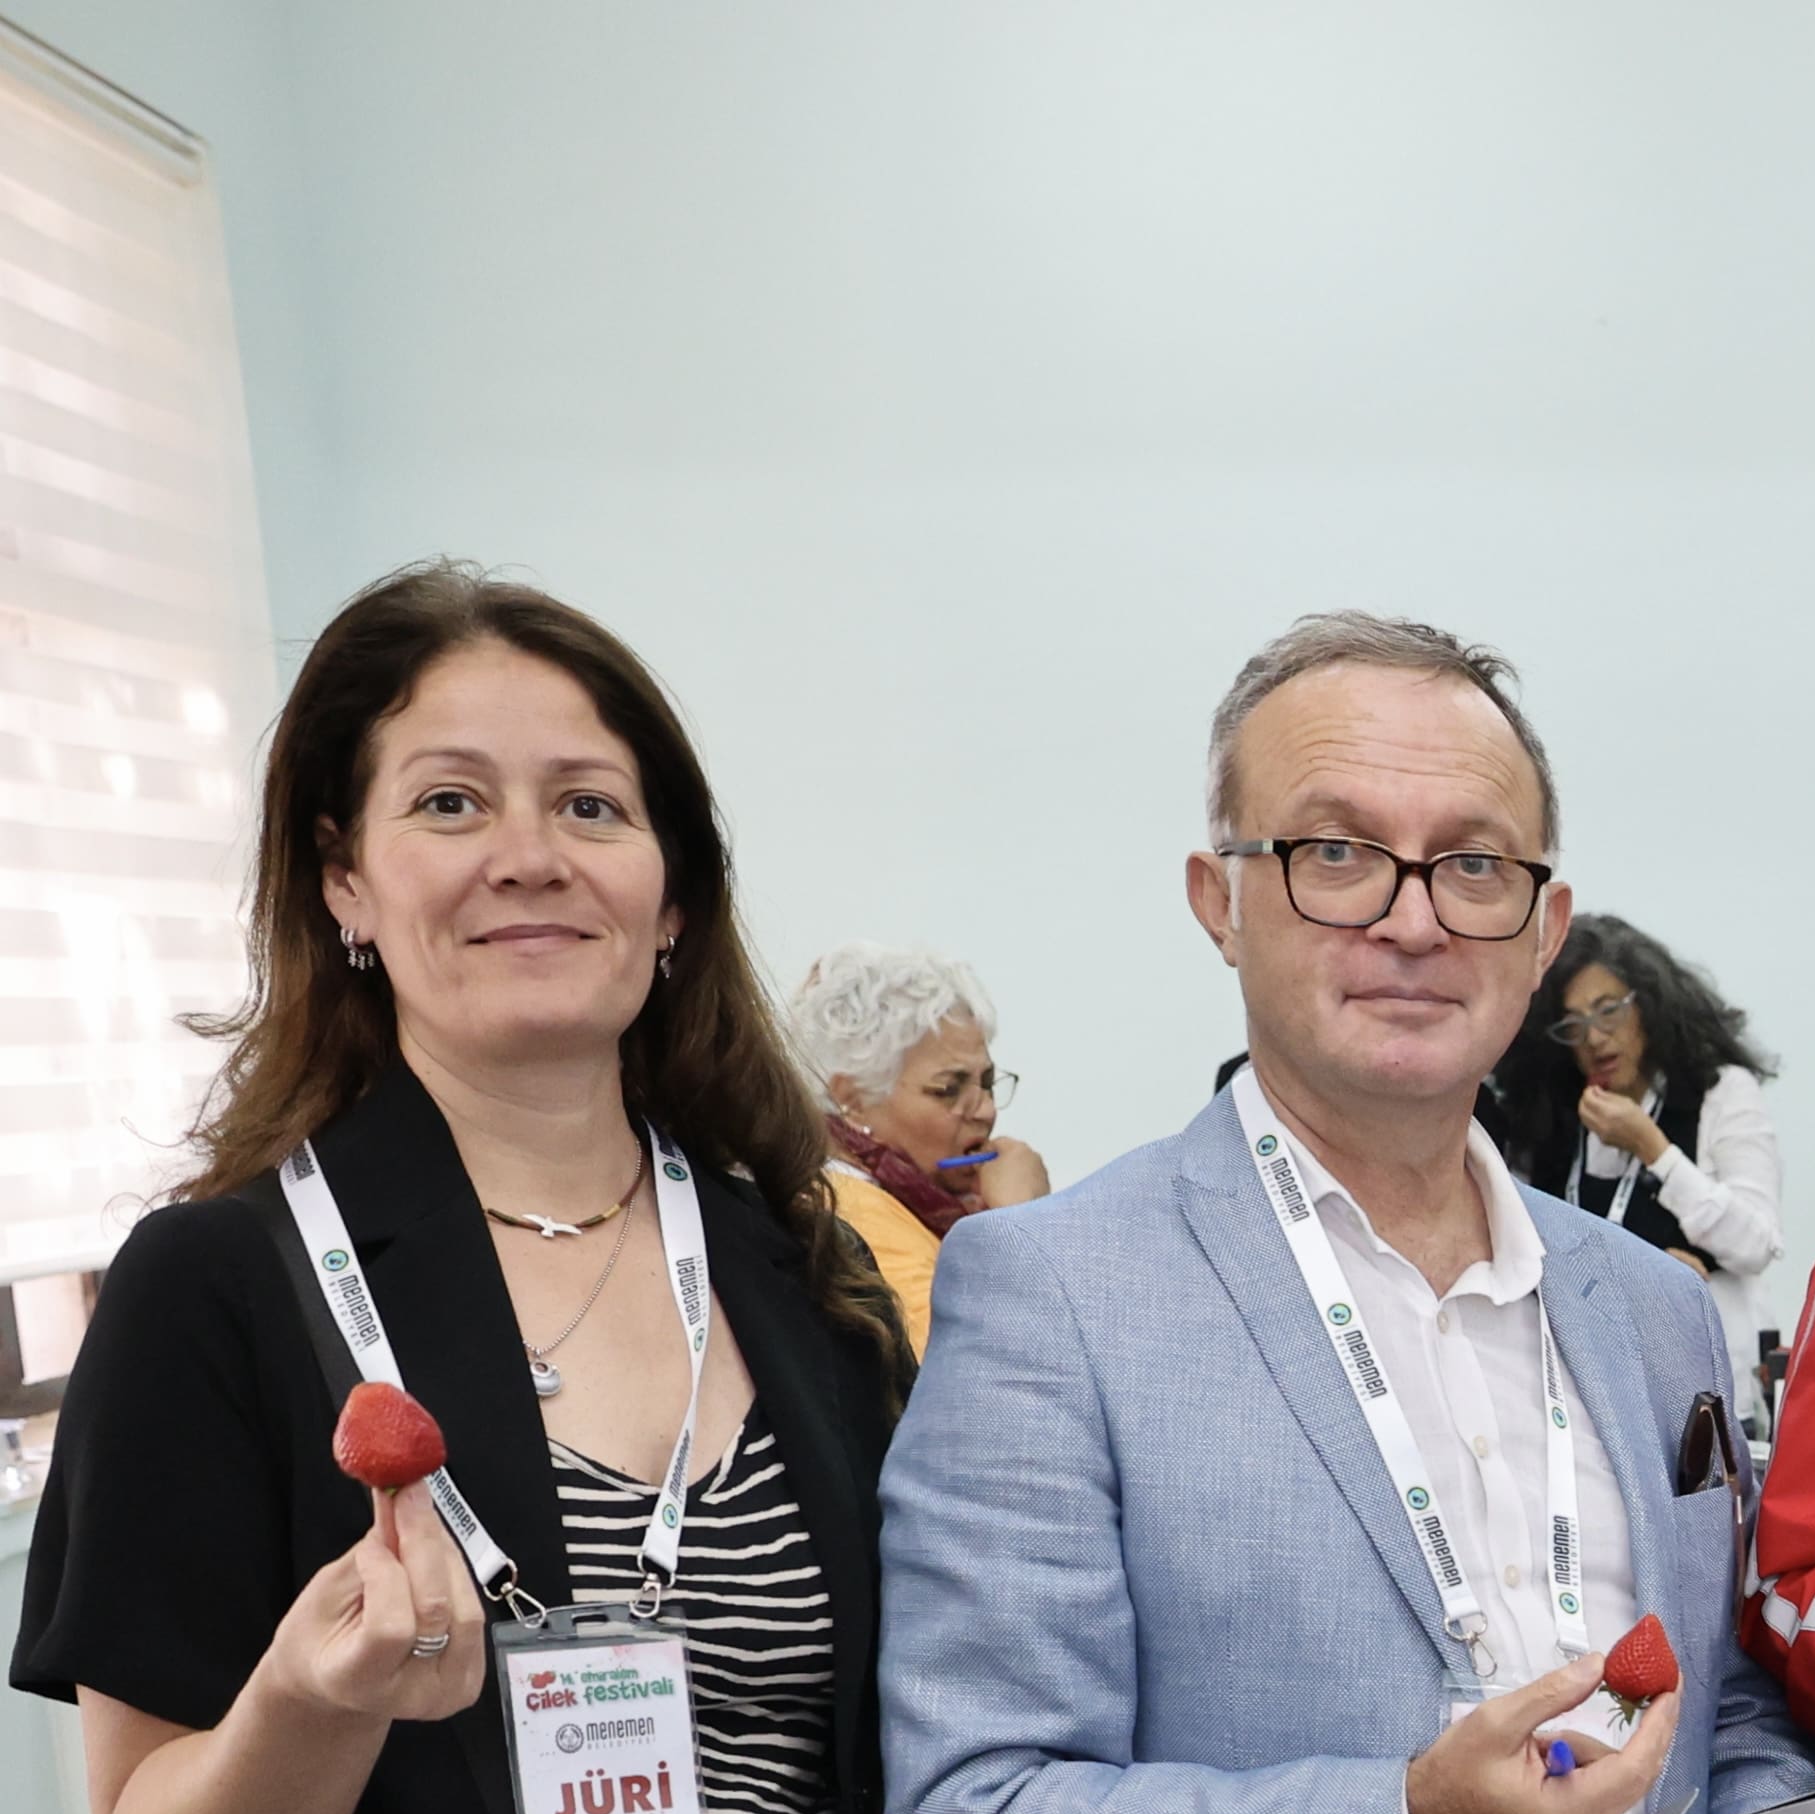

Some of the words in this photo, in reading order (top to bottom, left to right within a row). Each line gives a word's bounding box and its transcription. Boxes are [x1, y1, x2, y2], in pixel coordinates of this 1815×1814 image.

[1270, 1156, 1311, 1223] menemen
[336, 1273, 381, 1348] menemen
[675, 1256, 701, 1327] menemen
[1343, 1329, 1388, 1399] menemen
[1422, 1515, 1463, 1588] menemen
[1553, 1515, 1571, 1585] menemen
[525, 1688, 578, 1712] Çilek
[583, 1677, 675, 1706] festivali
[586, 1716, 655, 1741] menemen
